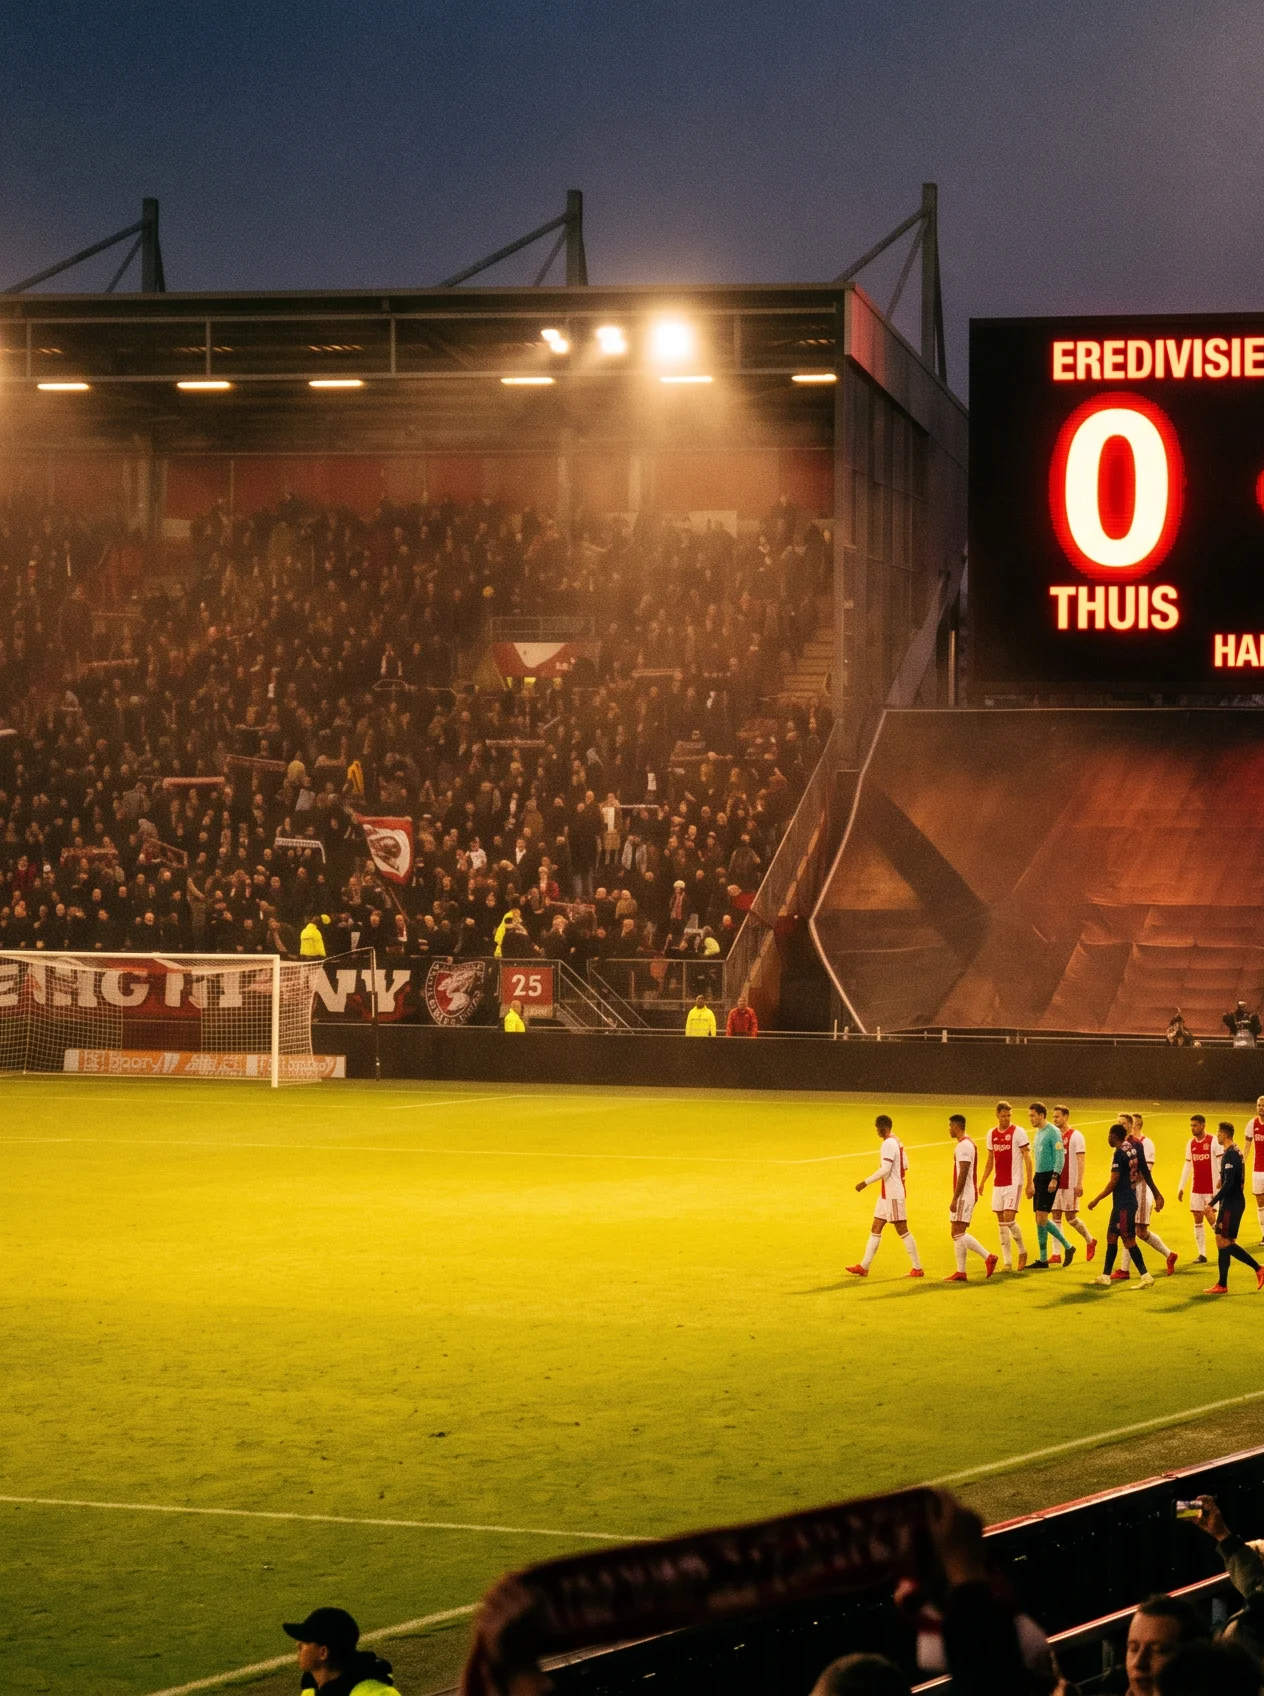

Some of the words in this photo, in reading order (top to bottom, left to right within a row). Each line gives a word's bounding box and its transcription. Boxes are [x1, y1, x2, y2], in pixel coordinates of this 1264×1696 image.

[1063, 406, 1170, 569] 0
[1049, 585, 1180, 631] THUIS
[511, 974, 543, 997] 25
